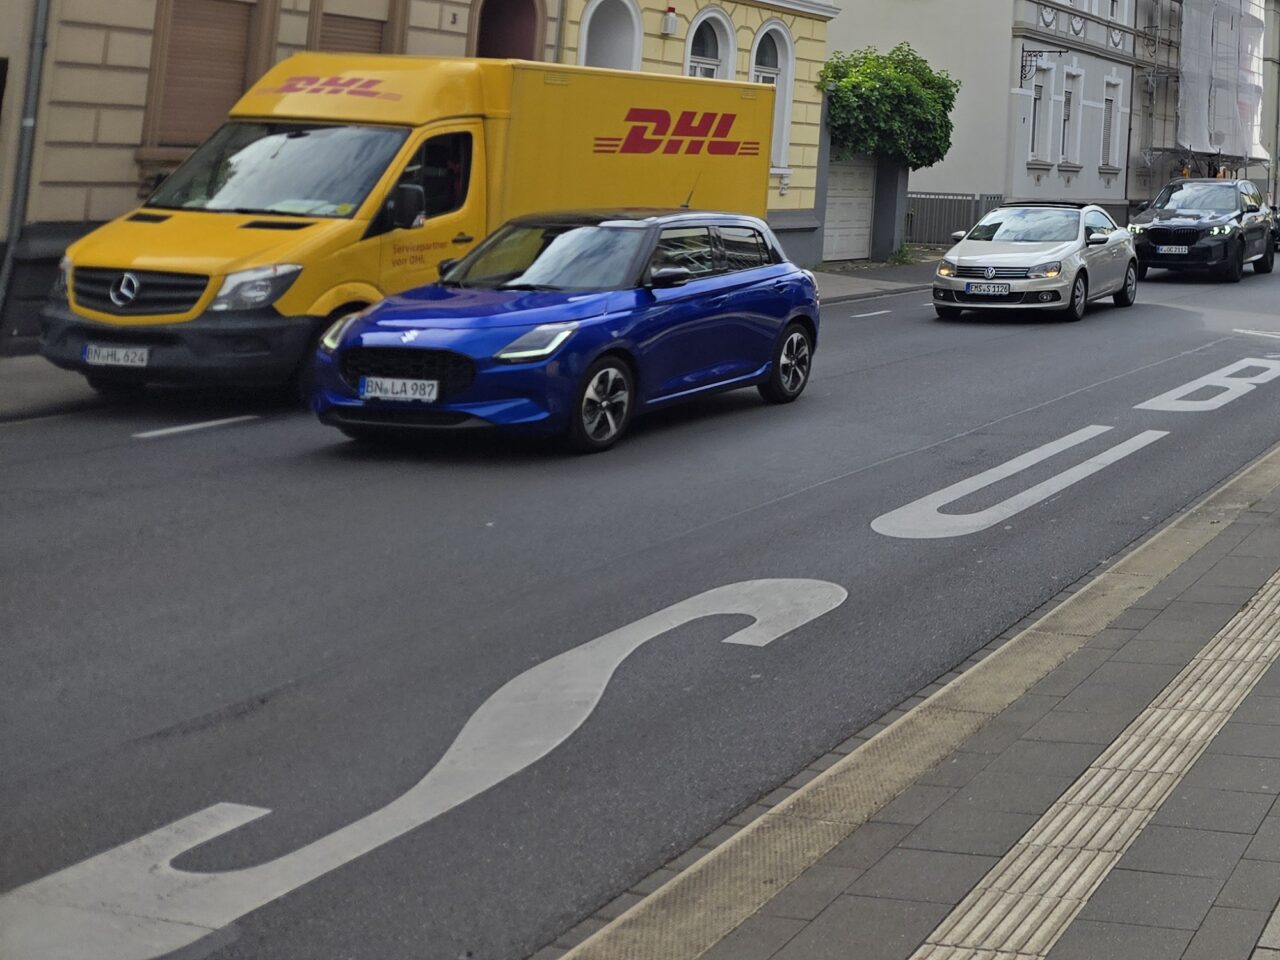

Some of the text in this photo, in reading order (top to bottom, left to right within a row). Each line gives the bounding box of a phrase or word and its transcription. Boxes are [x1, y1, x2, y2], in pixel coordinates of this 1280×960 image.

[280, 76, 384, 98] DHL
[618, 107, 741, 155] DHL
[366, 379, 435, 398] BN LA 987
